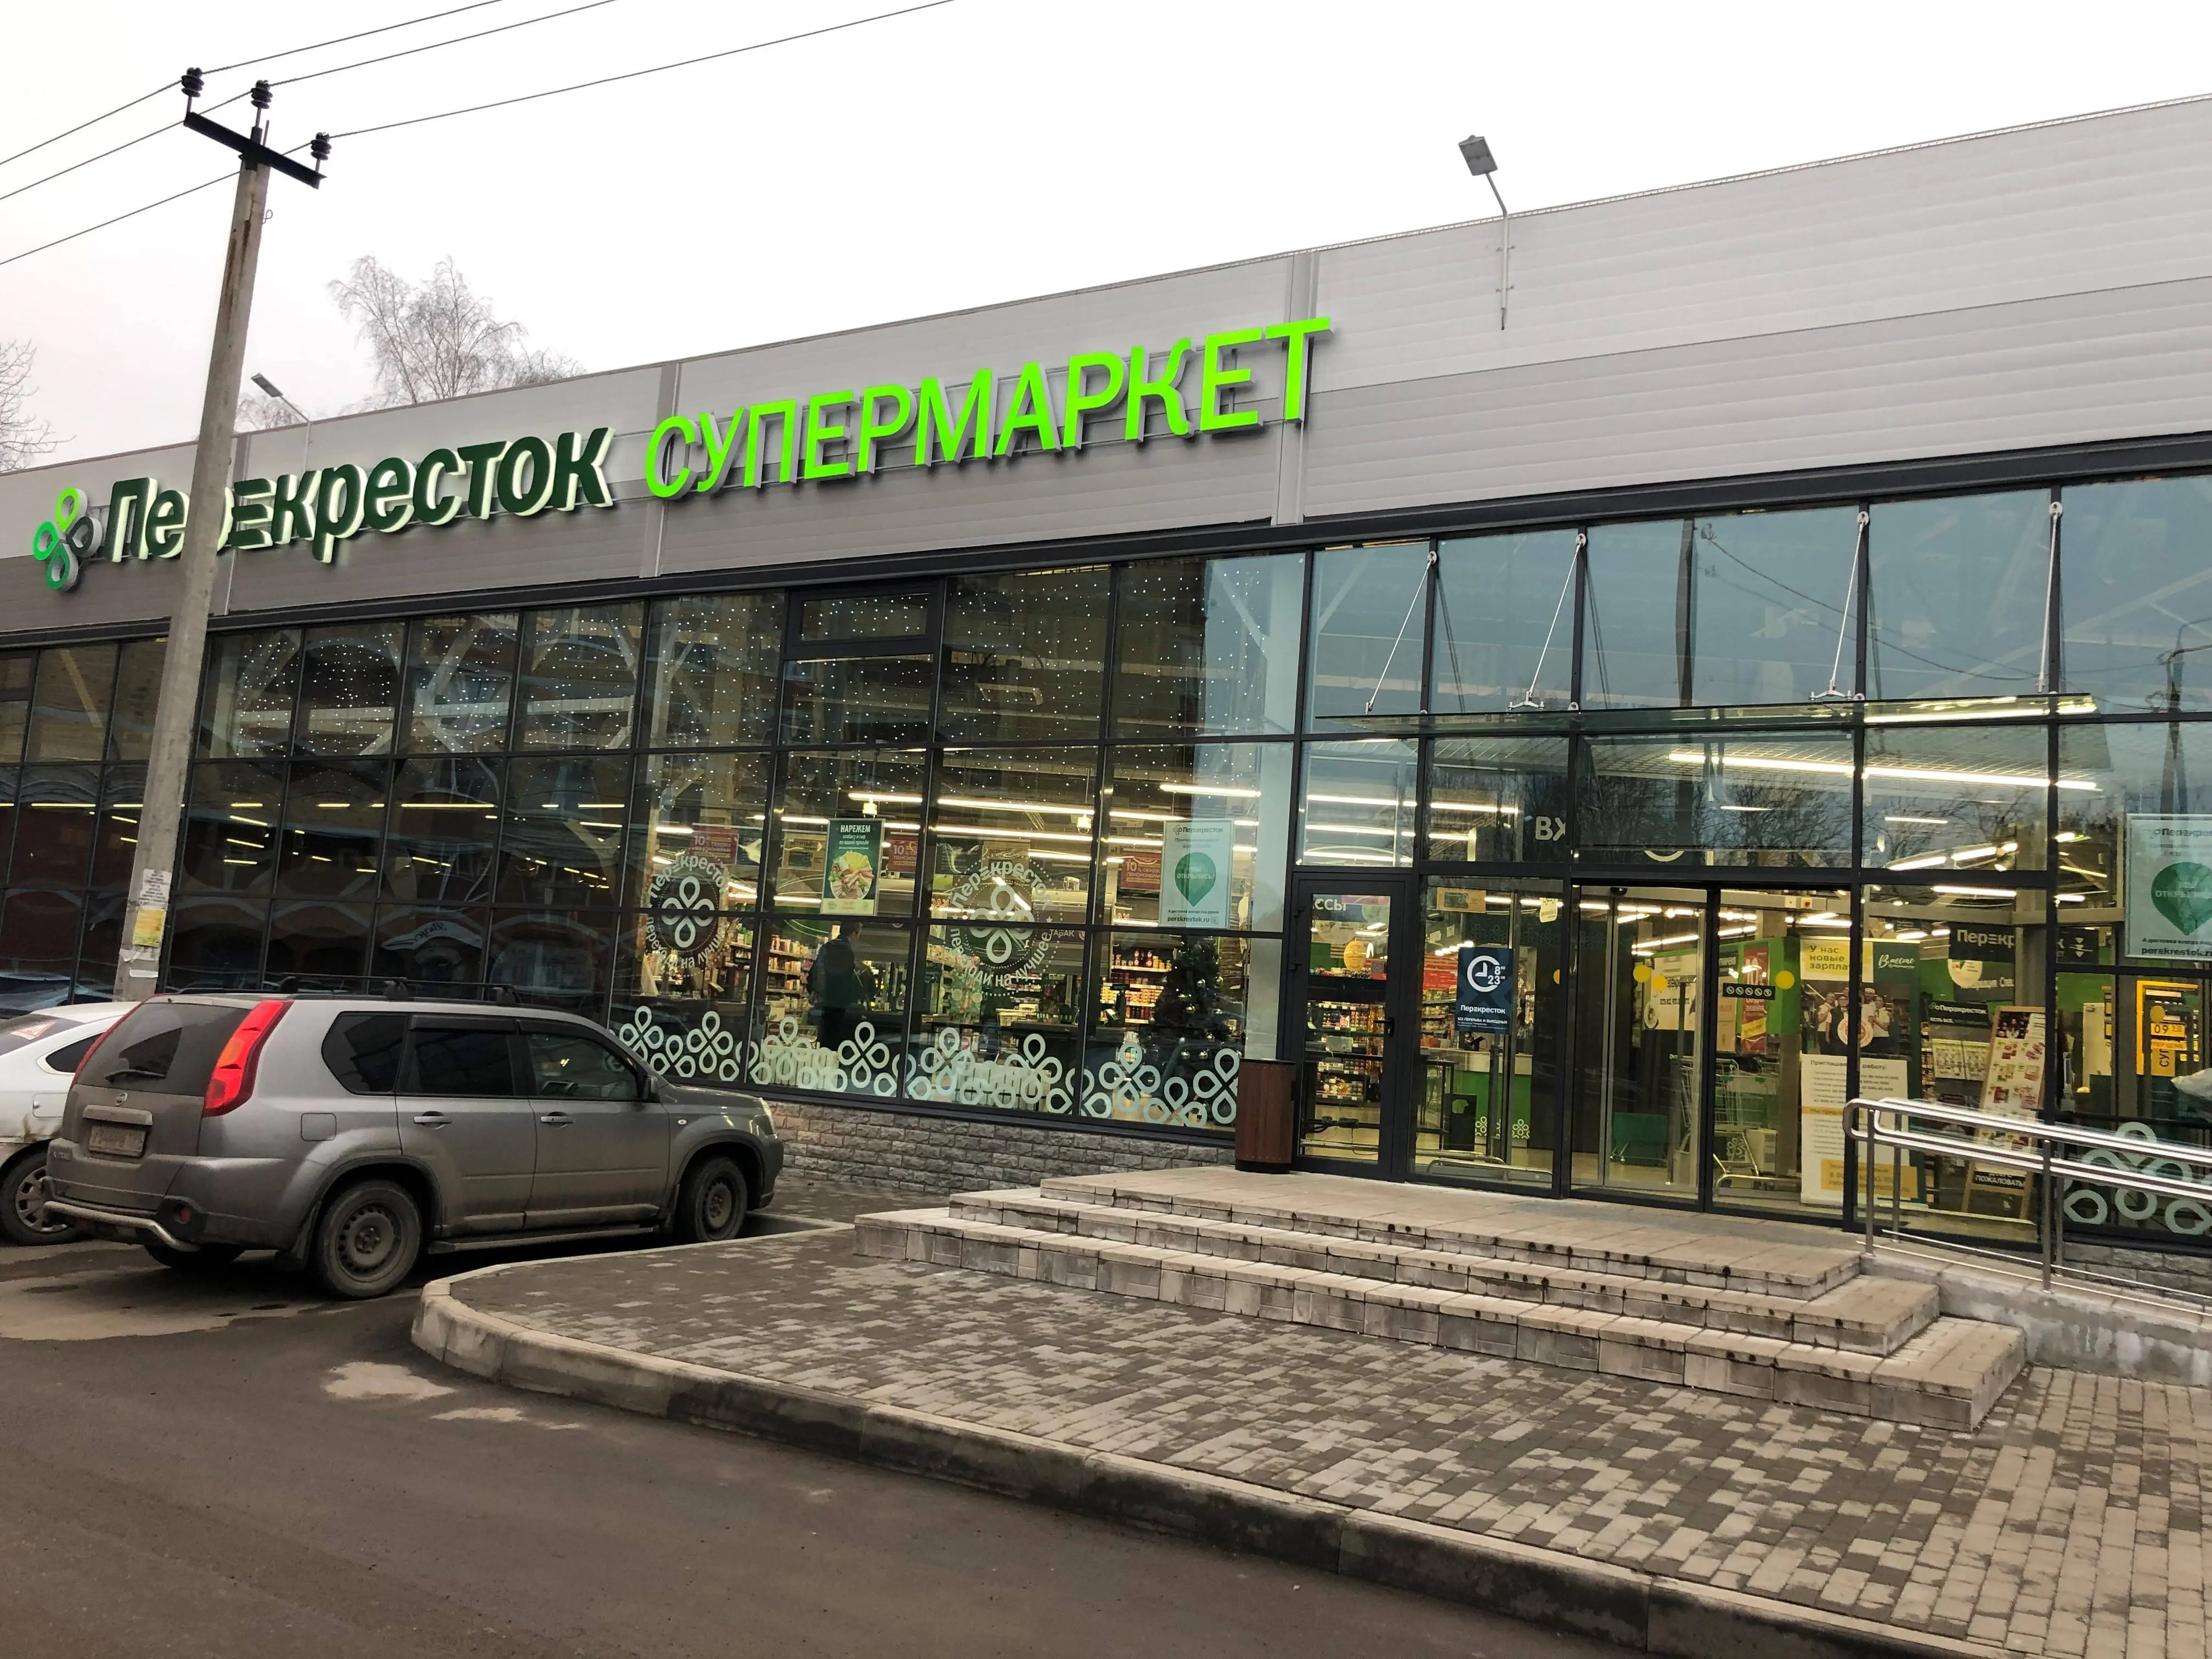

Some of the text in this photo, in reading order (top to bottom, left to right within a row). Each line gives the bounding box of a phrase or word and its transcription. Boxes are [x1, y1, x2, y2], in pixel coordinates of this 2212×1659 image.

[645, 317, 1335, 500] СУПЕРМАРКЕТ
[110, 427, 616, 563] Пеекресток
[840, 825, 871, 833] НАРЕЖЕМ
[893, 845, 905, 855] 10
[1126, 861, 1137, 872] 10
[647, 855, 727, 900] Перекресто
[952, 861, 1049, 911] Перекресток
[1313, 898, 1347, 911] ССЫ
[1049, 929, 1075, 937] ТАБАК
[1809, 962, 1850, 970] зарпла
[1460, 1005, 1506, 1014] Перекресток
